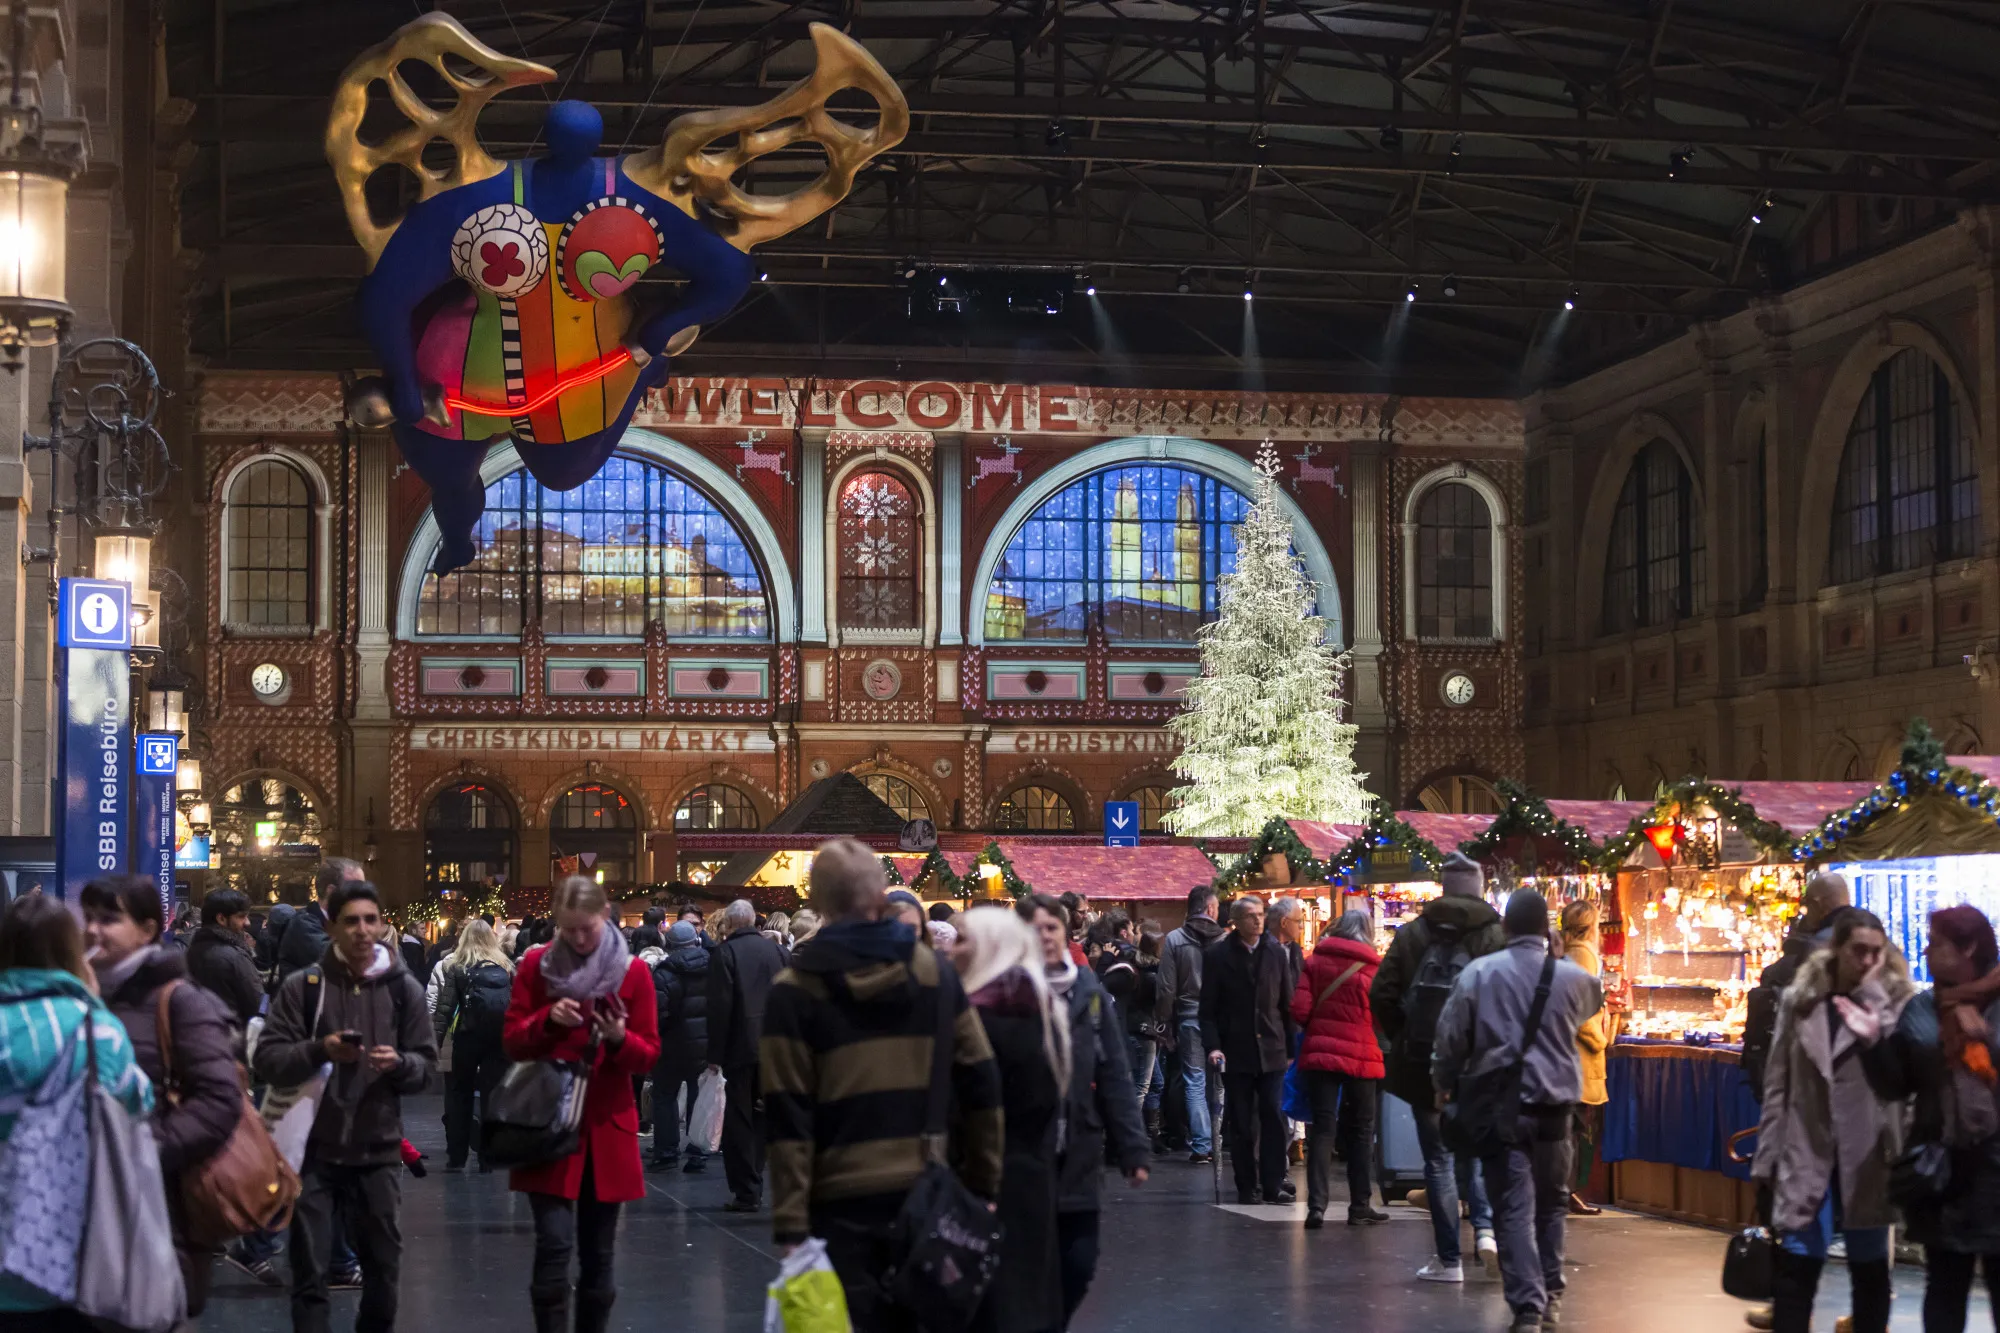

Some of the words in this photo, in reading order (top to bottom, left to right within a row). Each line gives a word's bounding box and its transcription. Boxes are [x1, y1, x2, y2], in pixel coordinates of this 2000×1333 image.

[657, 376, 1078, 431] WELCOME
[100, 697, 118, 813] Reisebüro
[426, 728, 622, 750] CHRISTKINDLI
[640, 725, 749, 750] MARKT
[99, 821, 117, 871] SBB
